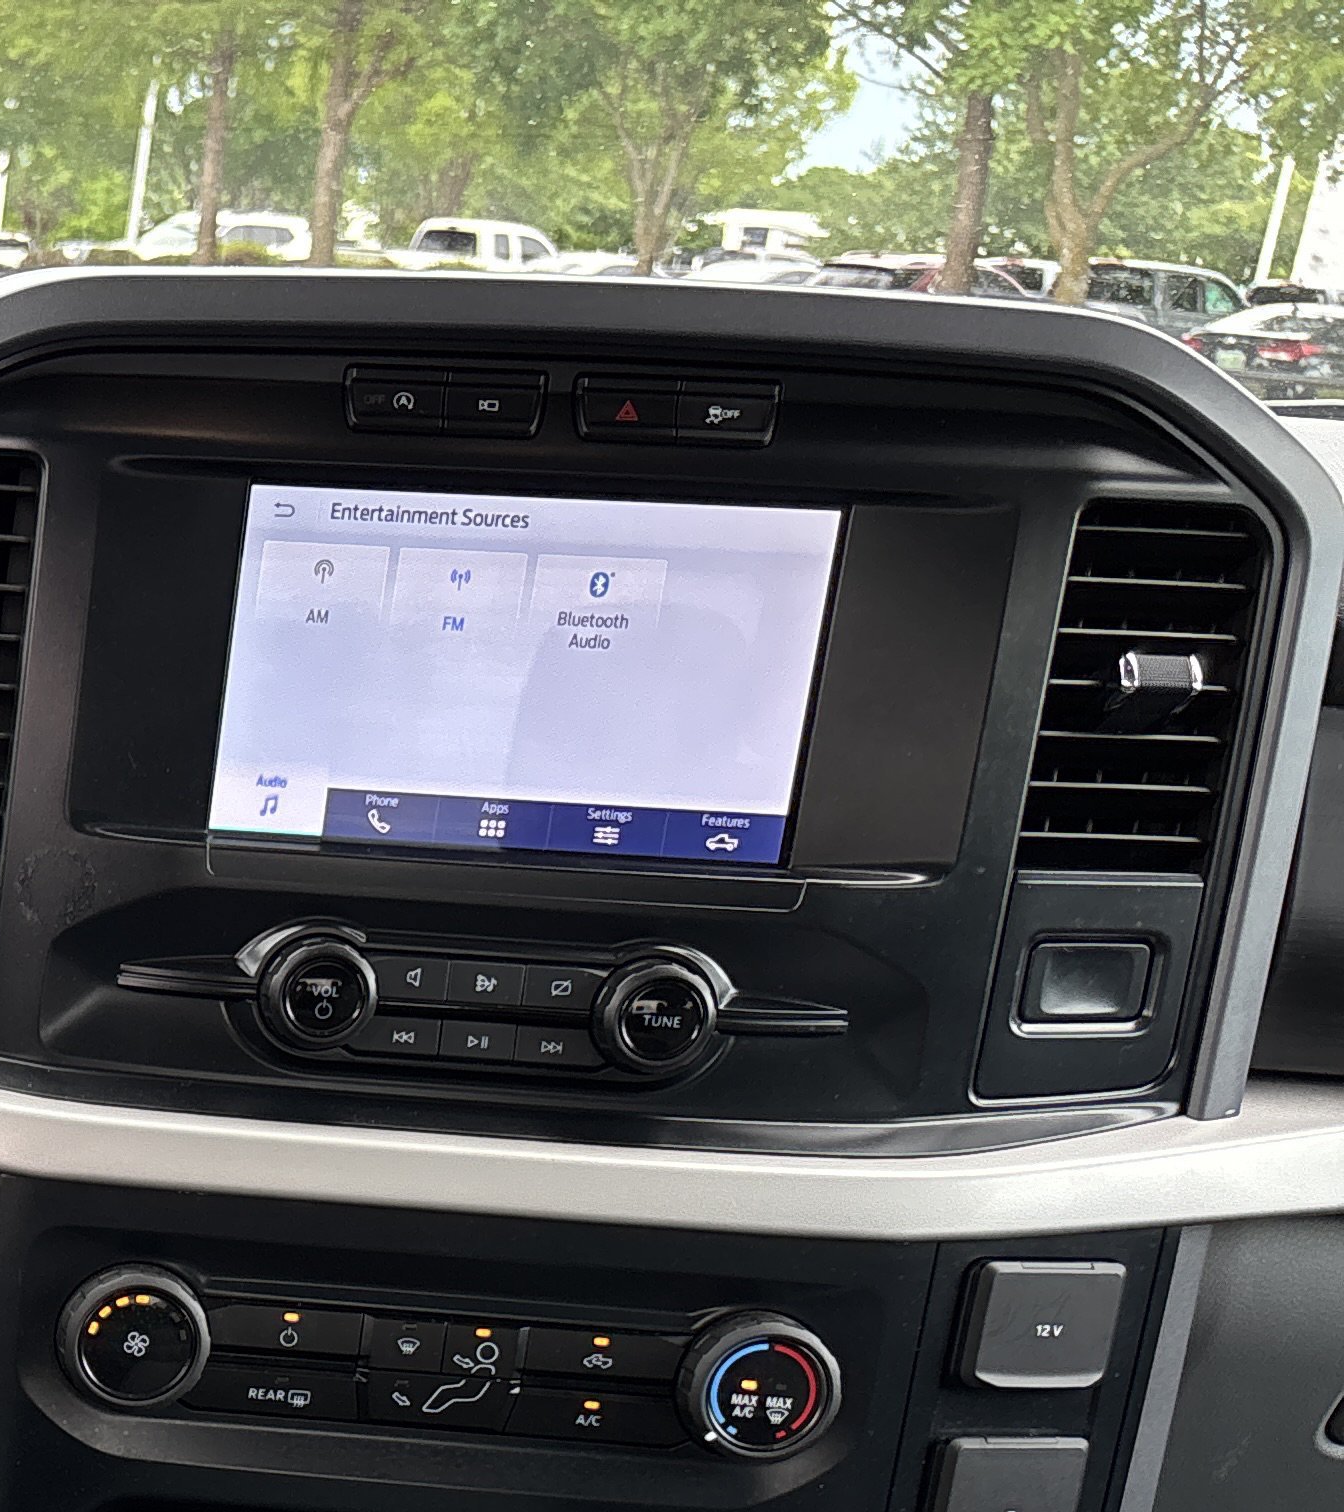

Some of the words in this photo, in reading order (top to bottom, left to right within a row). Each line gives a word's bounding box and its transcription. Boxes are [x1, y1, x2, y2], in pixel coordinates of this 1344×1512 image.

[721, 407, 742, 420] OFF
[330, 502, 459, 526] Entertainment
[460, 508, 530, 529] Sources
[305, 608, 330, 624] AM
[441, 616, 465, 632] FM
[557, 611, 629, 630] Bluetooth
[568, 633, 611, 650] Audio
[255, 774, 288, 789] Audio
[365, 793, 400, 809] Phone
[481, 801, 510, 816] Apps
[586, 807, 633, 824] Settings
[701, 813, 751, 830] Features
[311, 984, 340, 998] VOL
[642, 1013, 682, 1030] TUNE
[248, 1387, 286, 1403] REAR
[730, 1392, 758, 1408] MAX
[765, 1395, 794, 1411] MAX
[731, 1404, 755, 1419] A/C
[574, 1413, 602, 1427] A/C
